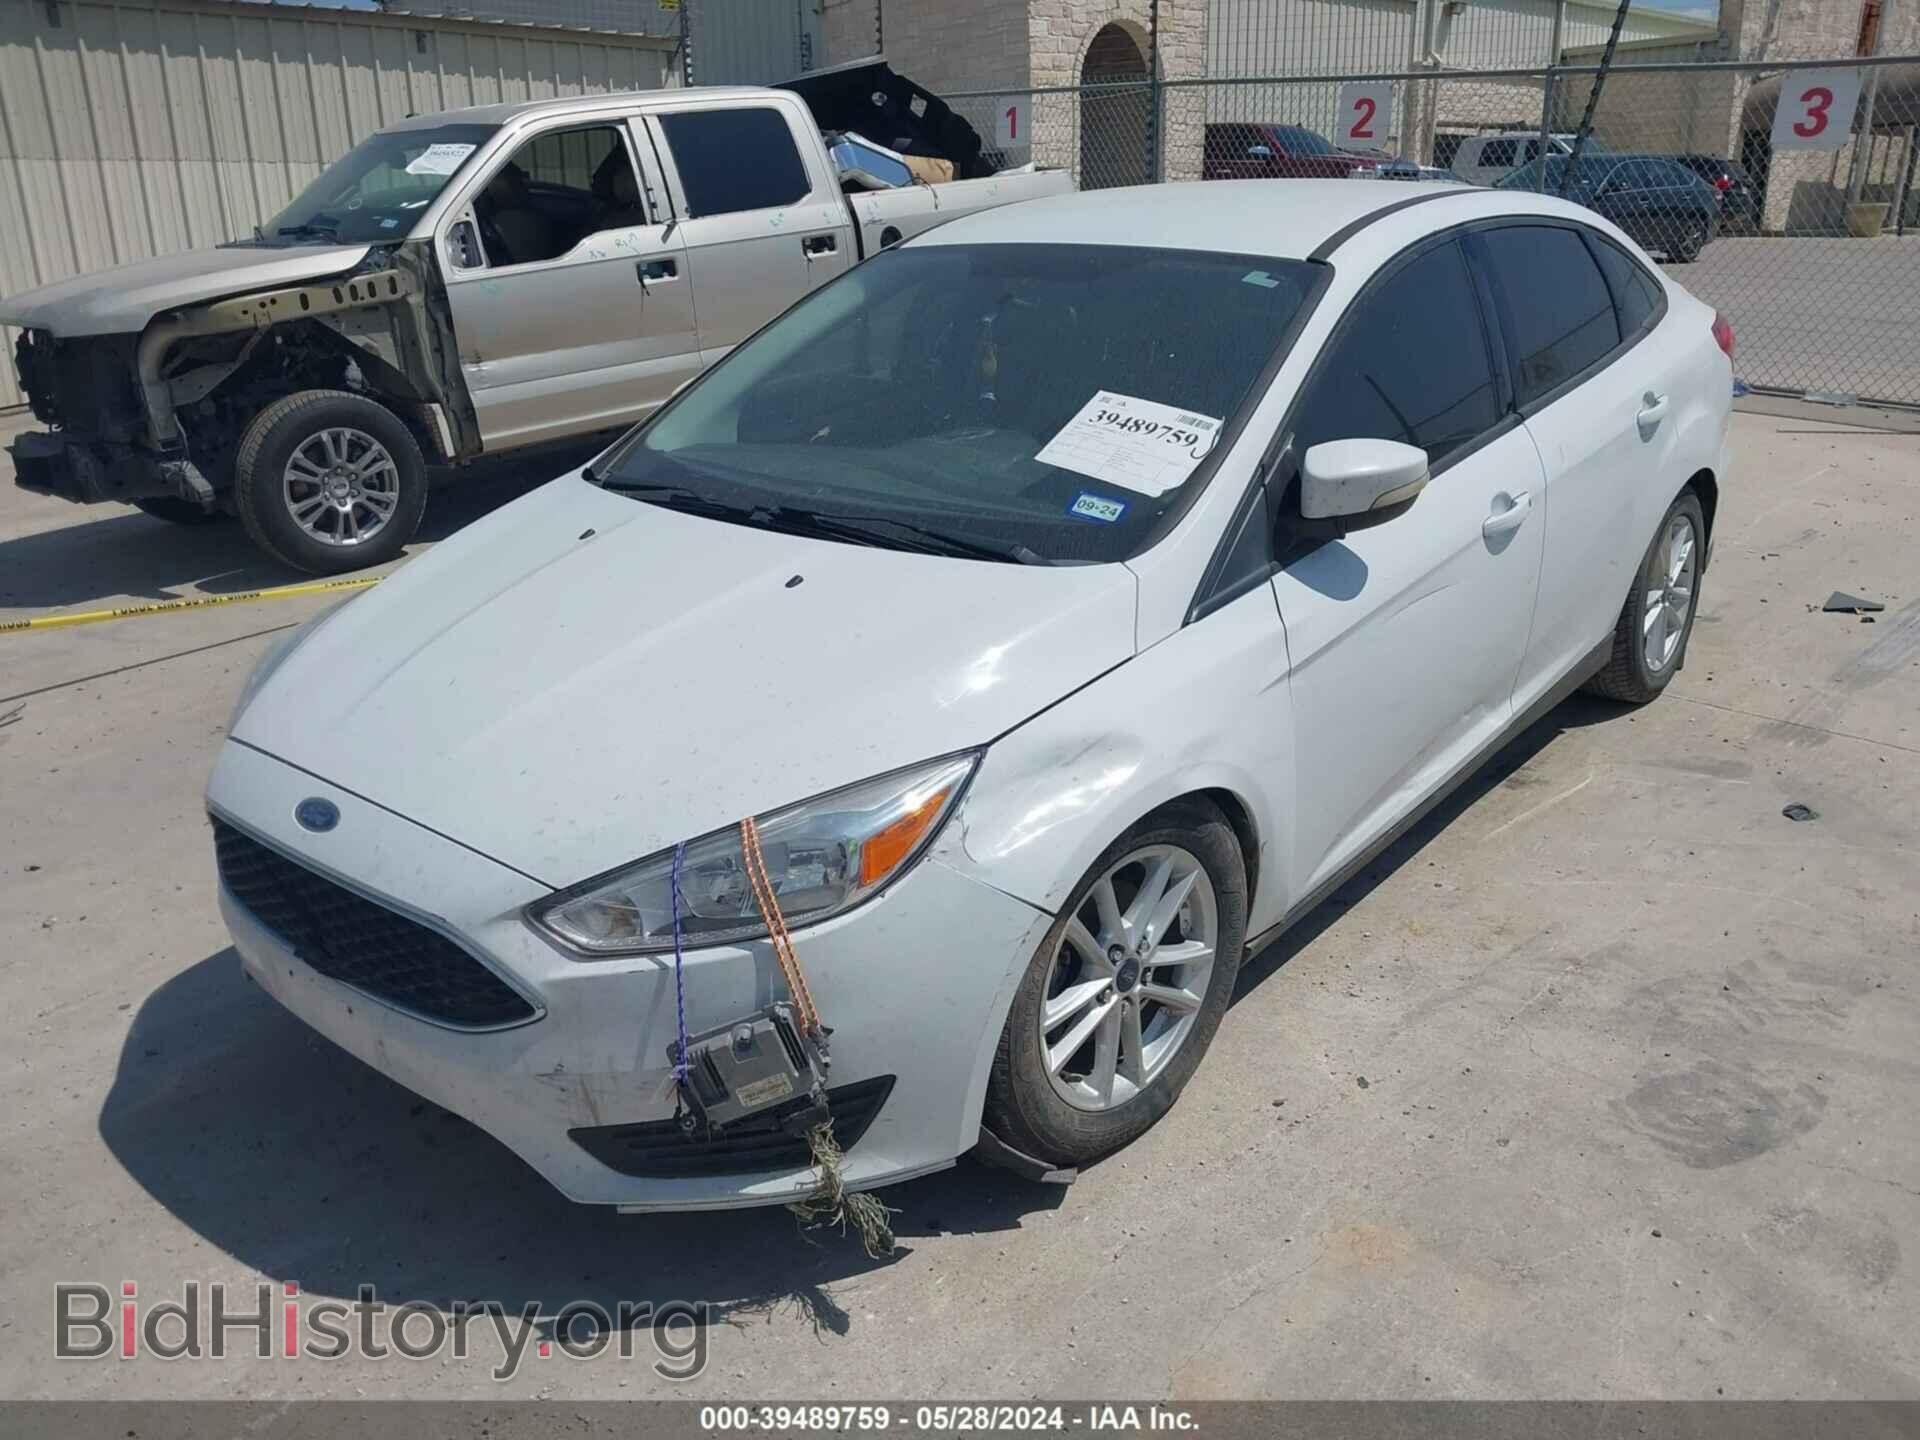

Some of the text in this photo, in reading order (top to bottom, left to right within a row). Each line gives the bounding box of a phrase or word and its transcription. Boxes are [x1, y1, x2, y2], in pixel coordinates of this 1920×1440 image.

[1006, 105, 1017, 139] 1
[1350, 97, 1376, 137] 2
[1793, 87, 1833, 137] 3
[1089, 409, 1200, 447] 39489759
